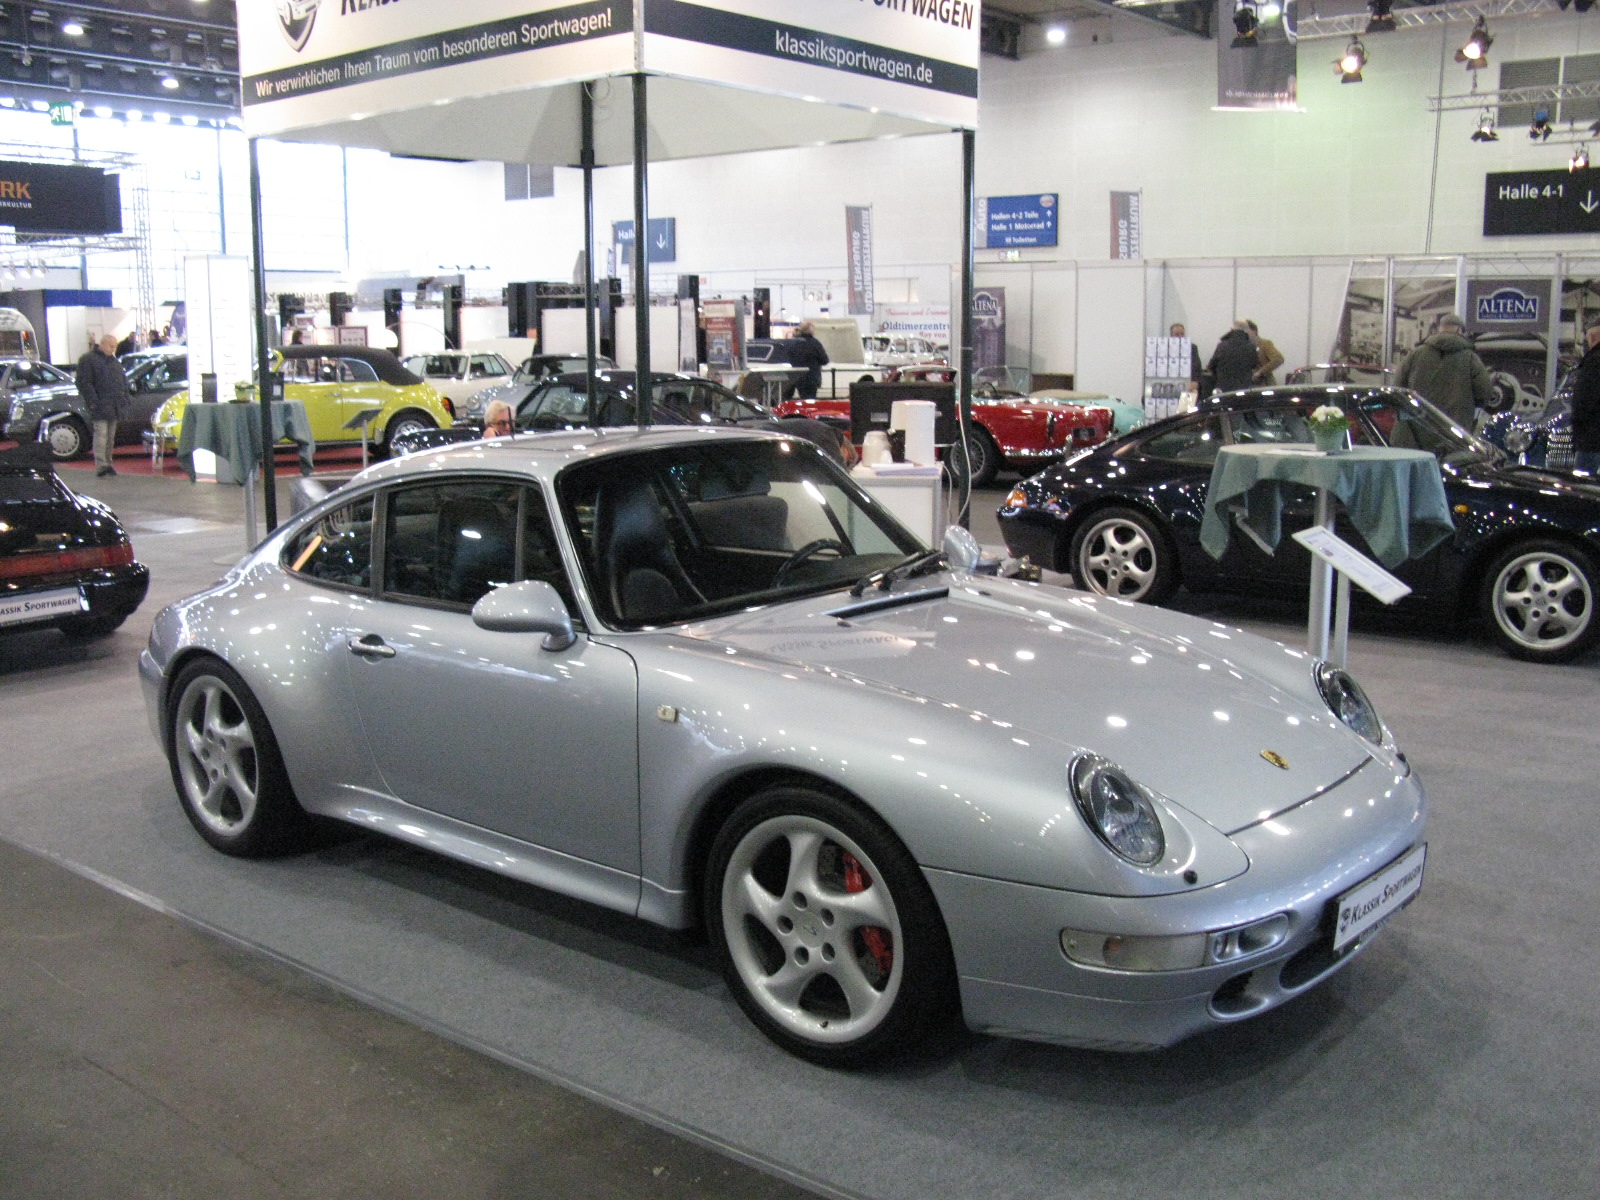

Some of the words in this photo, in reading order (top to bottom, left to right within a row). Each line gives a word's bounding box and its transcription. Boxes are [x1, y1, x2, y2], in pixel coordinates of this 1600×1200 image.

[255, 80, 273, 98] Wir
[275, 67, 341, 95] verwirklichen
[344, 61, 372, 79] Ihren
[374, 53, 411, 73] Traum
[413, 47, 440, 64] vom
[443, 28, 518, 59] besonderen
[521, 8, 613, 45] Sportwagen!
[775, 30, 934, 85] klassiksportwagen.de
[0, 181, 32, 200] RK
[1499, 184, 1539, 201] Halle
[1542, 184, 1564, 198] 4-1
[976, 199, 986, 232] Auto
[991, 212, 1011, 220] Hallen
[1024, 210, 1039, 219] Teile
[991, 223, 1007, 231] Halle
[1014, 221, 1045, 230] Motorrad
[971, 300, 997, 311] LTENA
[1480, 299, 1536, 313] ALTENA
[0, 605, 22, 615] ASSIK
